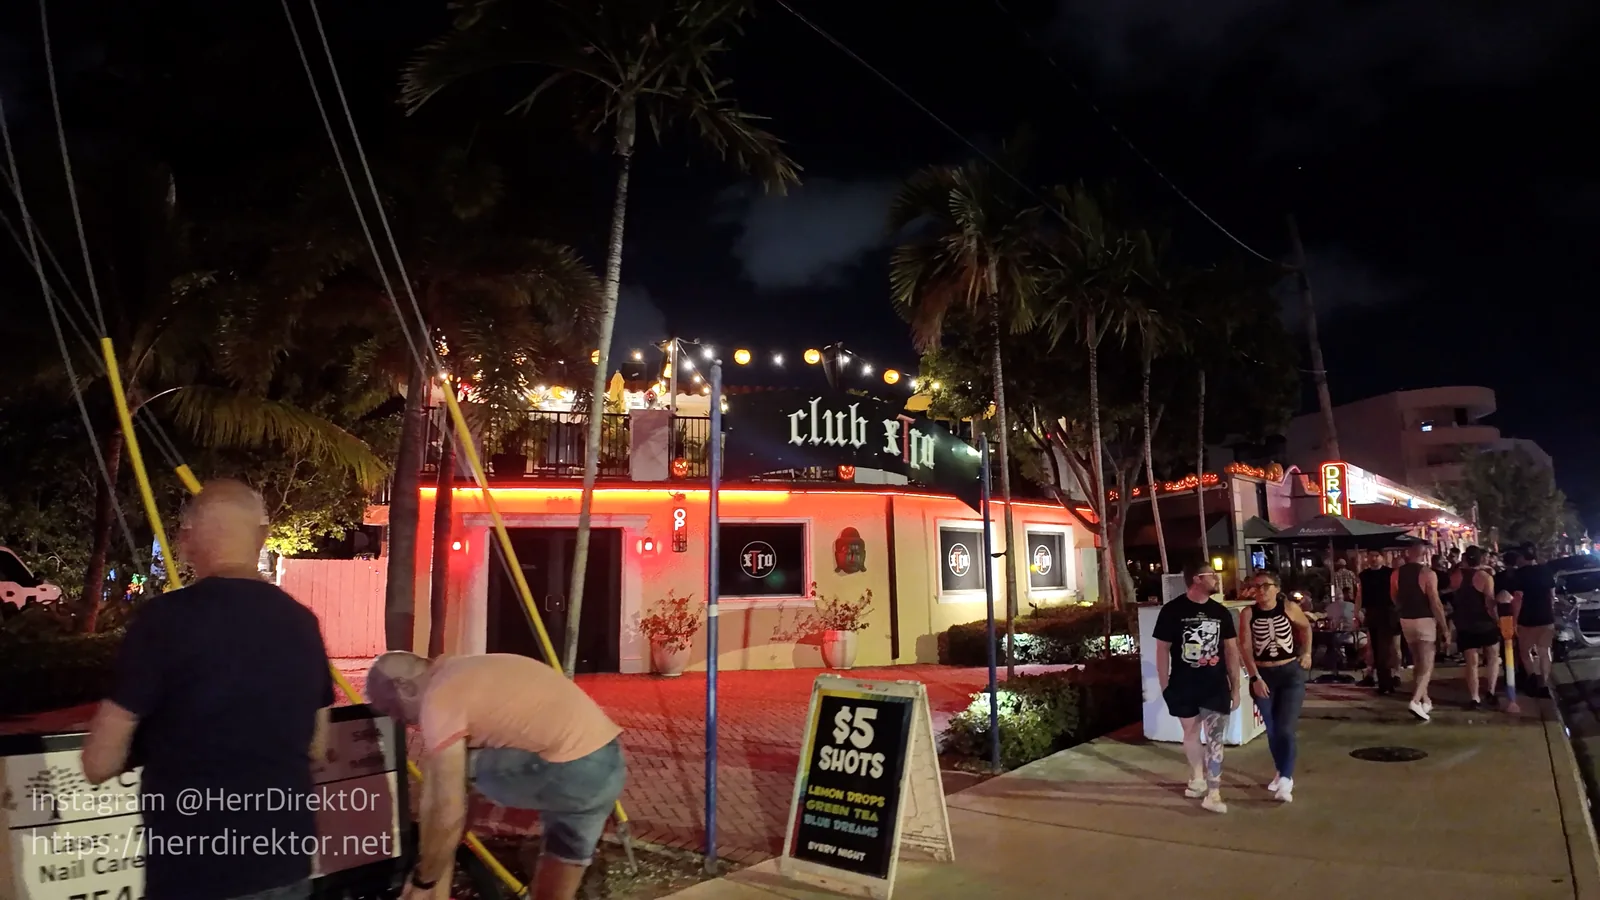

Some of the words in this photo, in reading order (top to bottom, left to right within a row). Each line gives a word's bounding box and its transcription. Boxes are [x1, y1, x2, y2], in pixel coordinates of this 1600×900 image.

[787, 396, 869, 449] club
[832, 705, 878, 749] $5
[818, 745, 885, 779] SHOTS
[808, 784, 845, 800] LEMON
[846, 790, 886, 808] DROPS
[806, 799, 850, 817] GREEN
[854, 807, 879, 822] TEA
[803, 813, 831, 829] BLUE
[833, 819, 879, 838] DREAMS
[807, 840, 837, 855] EVERY
[837, 847, 867, 862] NIGHT
[39, 859, 85, 883] Nail
[92, 856, 146, 875] Care
